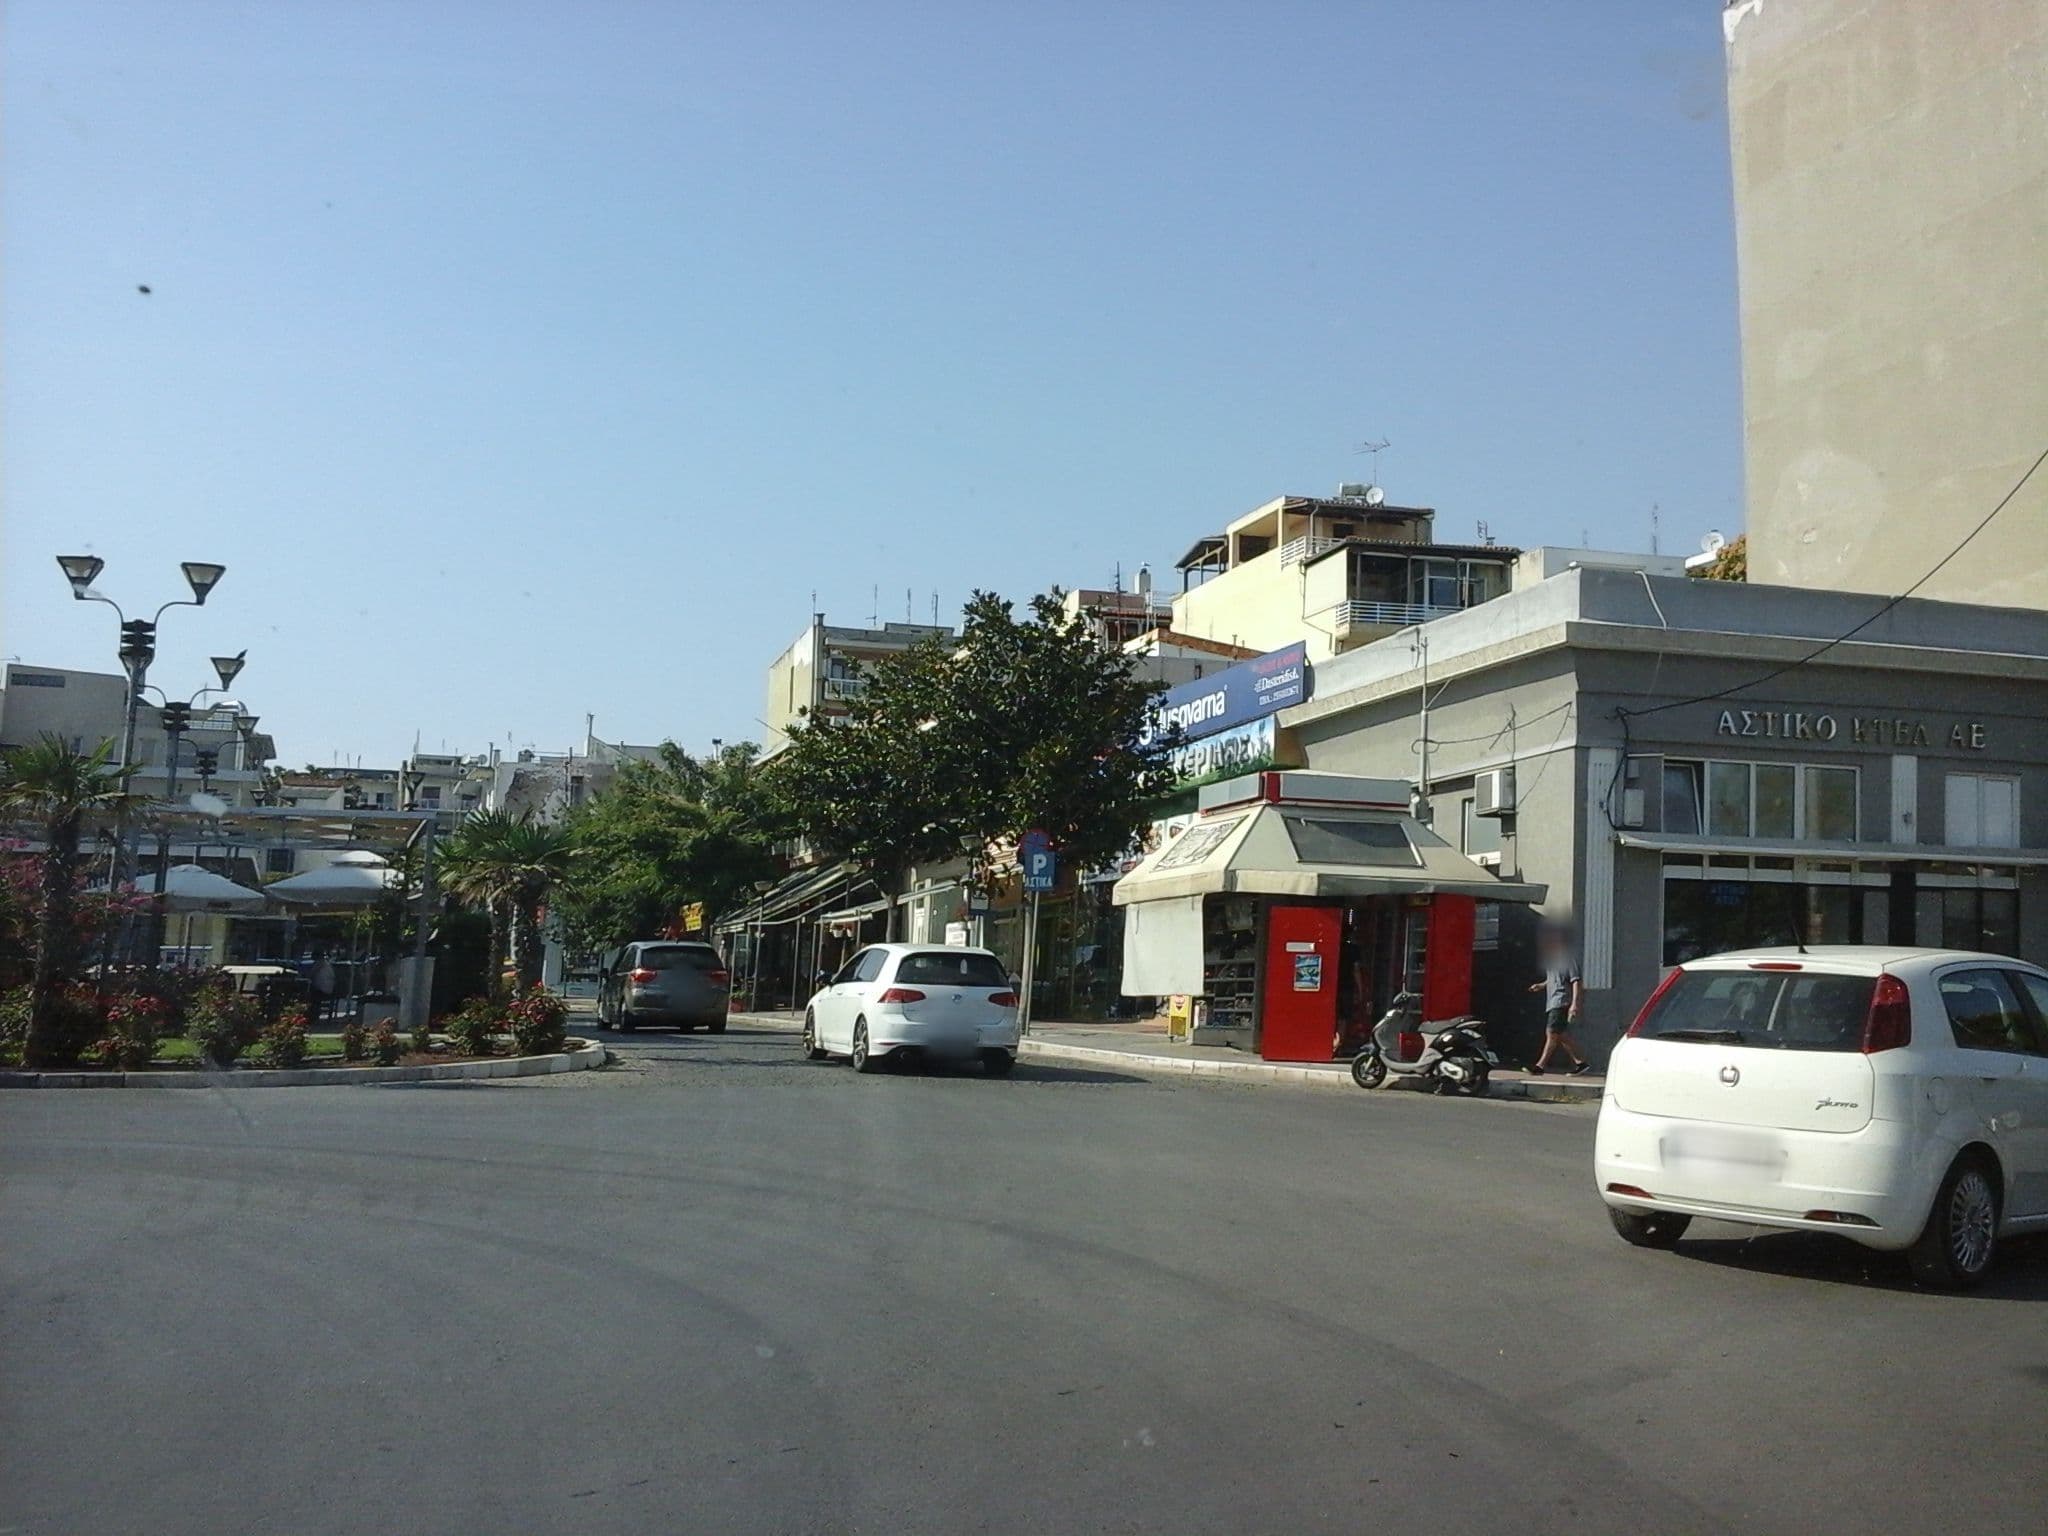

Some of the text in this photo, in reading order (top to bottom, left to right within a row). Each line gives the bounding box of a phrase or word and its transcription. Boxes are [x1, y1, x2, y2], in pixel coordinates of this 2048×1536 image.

[1718, 709, 1837, 741] ΑΣΤΙΚΟ
[1950, 723, 1986, 749] ΑΕ
[1033, 854, 1047, 875] P
